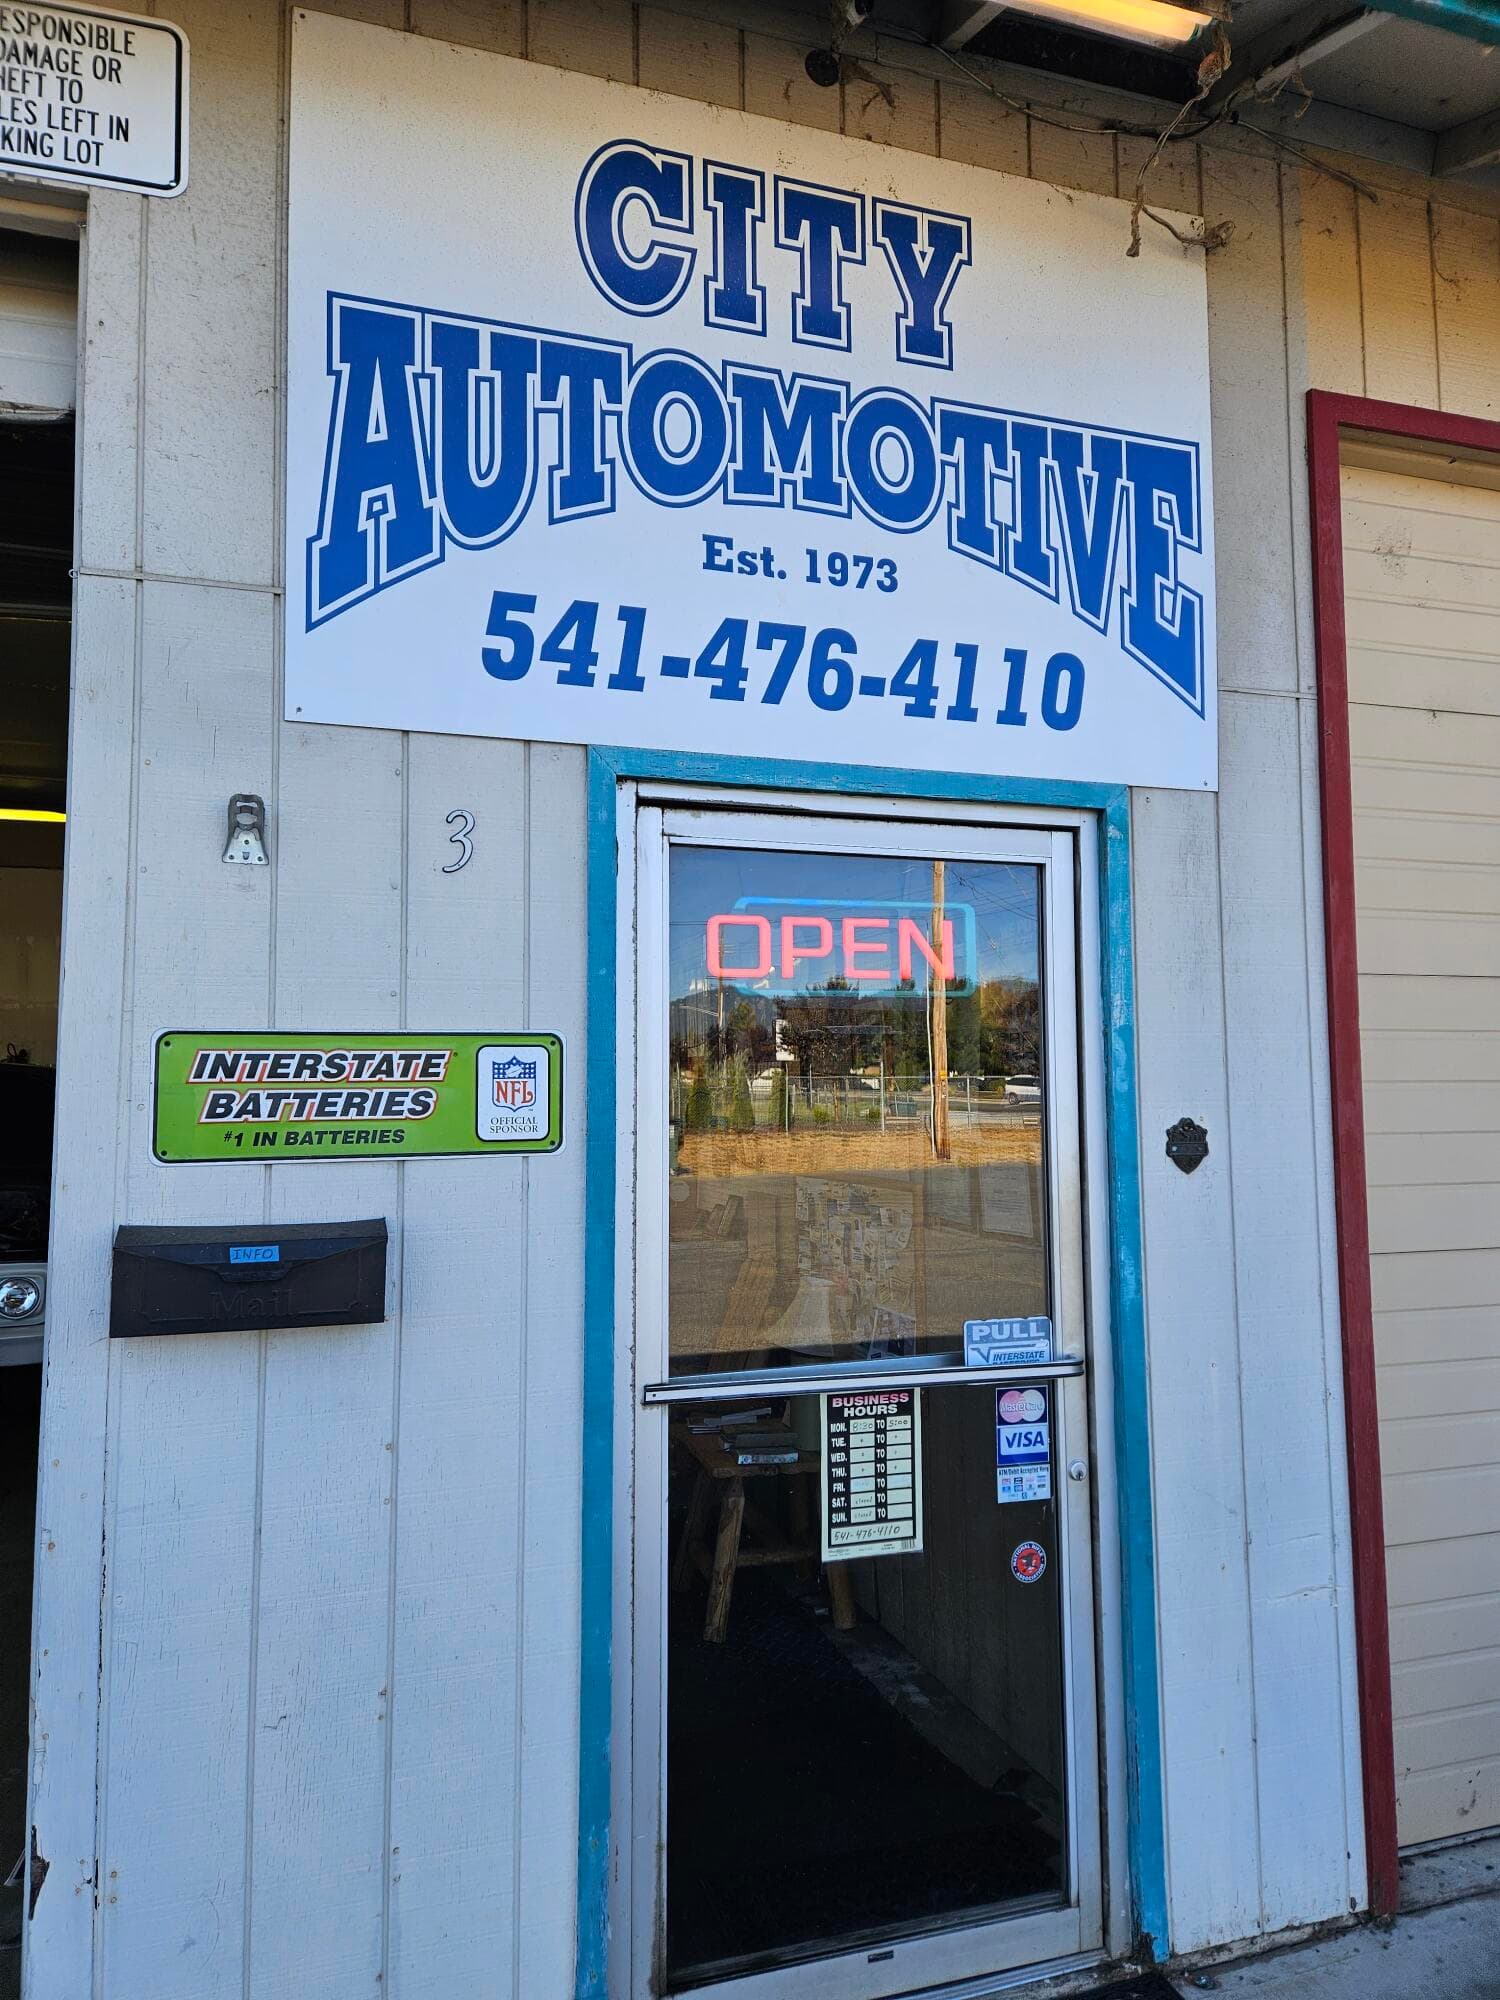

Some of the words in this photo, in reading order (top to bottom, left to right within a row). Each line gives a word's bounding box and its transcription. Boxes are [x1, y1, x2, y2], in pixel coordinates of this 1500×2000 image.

[0, 6, 136, 56] ESPONSIBLE
[92, 55, 122, 84] OR
[56, 75, 83, 104] TO
[0, 96, 37, 125] LES
[47, 103, 99, 136] LEFT
[109, 114, 129, 142] IN
[1, 125, 54, 158] KING
[63, 135, 104, 166] LOT
[574, 138, 972, 371] CITY
[306, 290, 1206, 721] AUTOMOTIVE
[702, 533, 787, 580] Est.
[805, 548, 899, 593] 1973
[481, 590, 1086, 732] 541-476-4110
[442, 809, 475, 874] 3
[706, 914, 955, 981] OPEN
[187, 1049, 451, 1083] INTERSTATE
[495, 1080, 534, 1106] NFL
[199, 1088, 438, 1123] BATTERIES
[490, 1116, 538, 1125] OFFICIAL
[490, 1124, 538, 1133] SPONSOR
[223, 1130, 244, 1147] #1
[253, 1131, 279, 1147] IN
[284, 1129, 405, 1146] BATTERIES
[233, 1248, 274, 1260] INFO
[208, 1288, 297, 1320] Mail
[972, 1322, 1046, 1341] PULL
[993, 1350, 1046, 1362] INTERSTATE
[832, 1392, 910, 1408] BUSINESS
[843, 1404, 898, 1417] HOURS
[830, 1422, 847, 1433] MON.
[876, 1419, 885, 1429] TO
[831, 1437, 846, 1448] TUE.
[876, 1434, 885, 1444] TO
[1005, 1431, 1045, 1448] VISA
[831, 1452, 847, 1463] WED.
[876, 1449, 885, 1458] TO
[831, 1467, 847, 1478] THU.
[876, 1464, 885, 1473] TO
[832, 1482, 846, 1493] FRI.
[877, 1478, 885, 1488] TO
[831, 1497, 847, 1508] SAT.
[877, 1493, 886, 1503] TO
[831, 1512, 847, 1524] SUN.
[877, 1508, 886, 1518] TO
[834, 1525, 901, 1541] 541-476-4110
